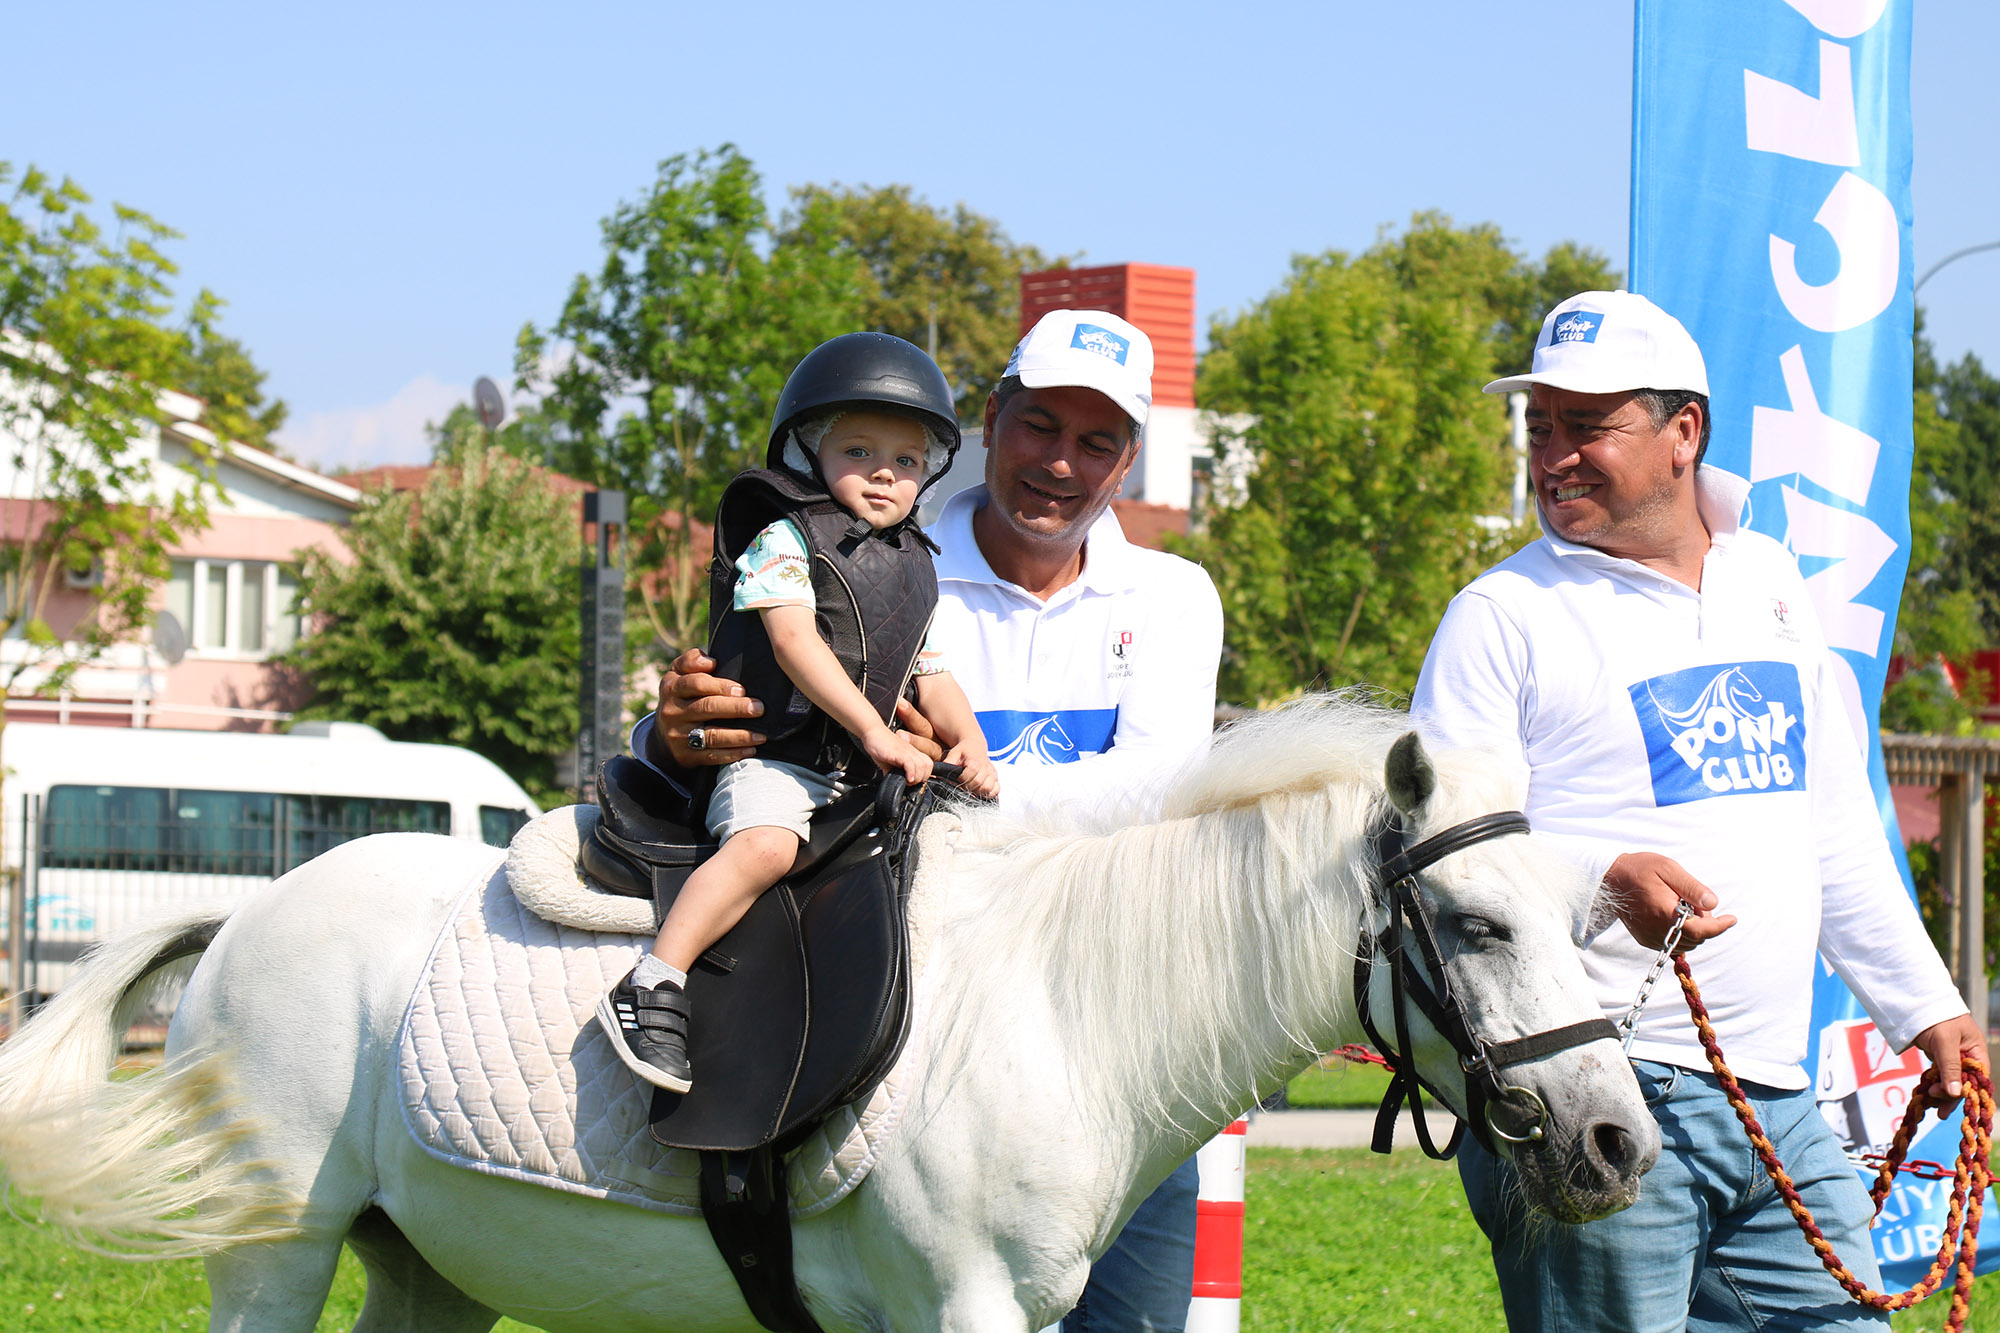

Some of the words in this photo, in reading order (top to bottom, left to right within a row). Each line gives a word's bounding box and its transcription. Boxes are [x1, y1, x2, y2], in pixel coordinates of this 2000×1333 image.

[1556, 320, 1595, 337] PONY
[1559, 333, 1585, 342] CLUB
[1079, 334, 1124, 353] PONY
[1086, 343, 1118, 360] CLUB
[1670, 701, 1797, 771] PONY
[1702, 753, 1794, 793] CLUB
